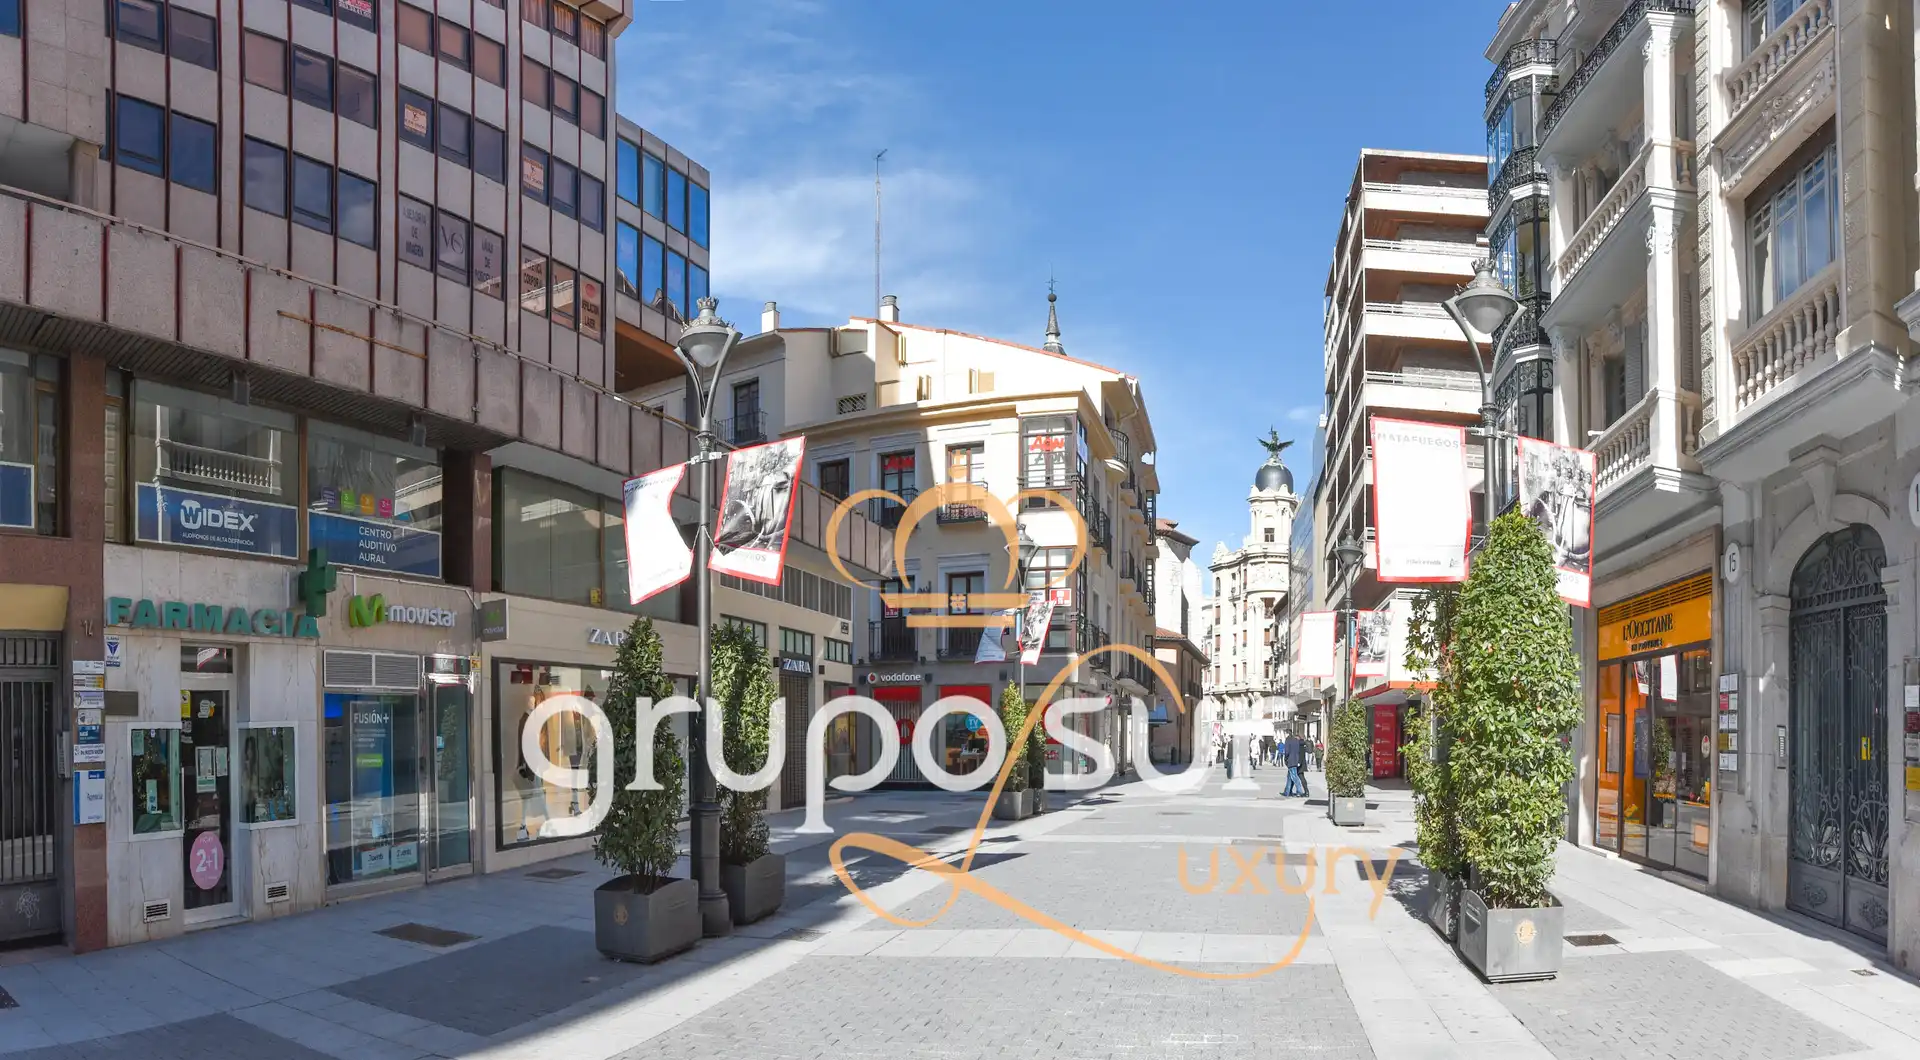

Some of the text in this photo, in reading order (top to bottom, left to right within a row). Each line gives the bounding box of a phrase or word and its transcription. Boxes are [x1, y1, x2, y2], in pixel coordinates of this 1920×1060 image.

[359, 526, 392, 539] CENTRO
[359, 540, 397, 553] AUDITIVO
[359, 552, 387, 564] AURAL
[1729, 552, 1736, 572] 15
[107, 596, 320, 638] FARMACIA
[389, 605, 458, 627] movistar
[588, 628, 625, 646] ZAR
[782, 658, 812, 674] ZARA
[880, 672, 922, 682] vodafone
